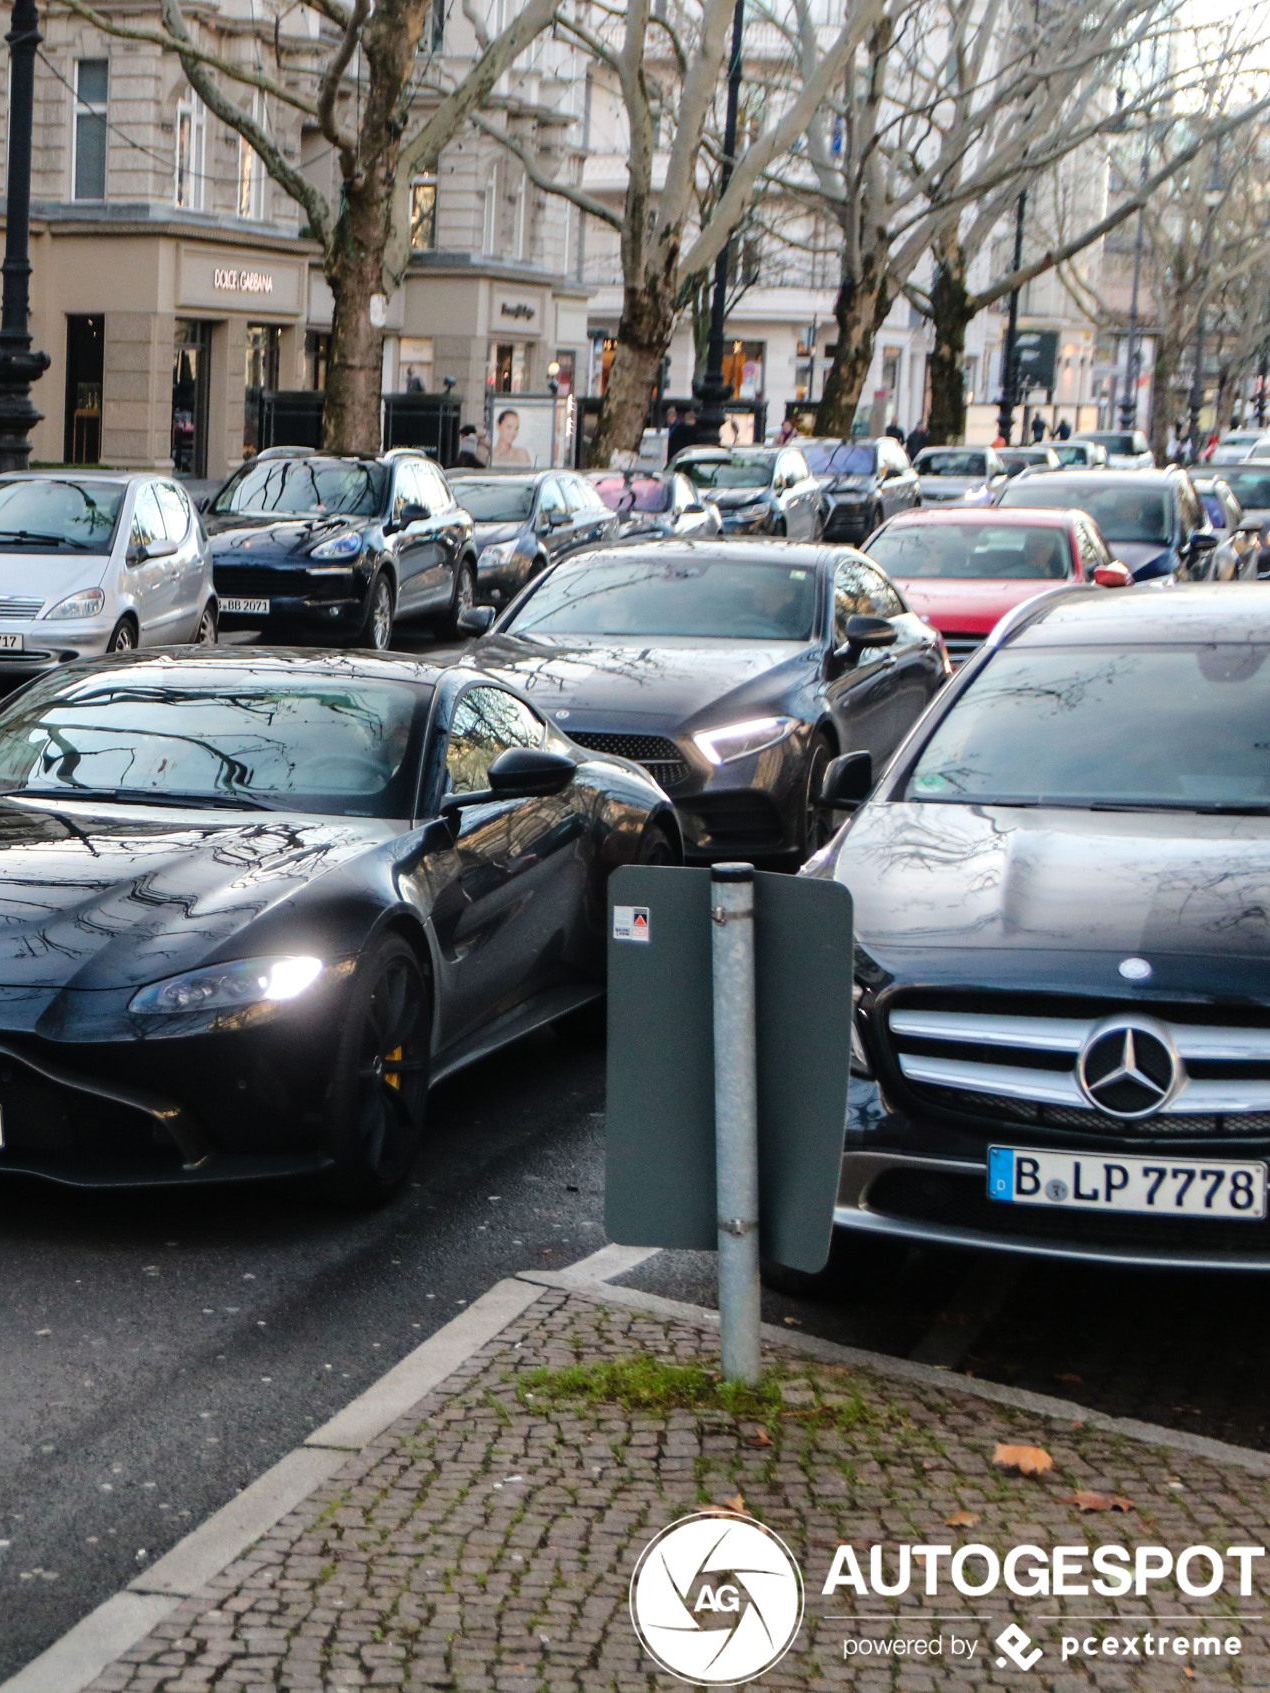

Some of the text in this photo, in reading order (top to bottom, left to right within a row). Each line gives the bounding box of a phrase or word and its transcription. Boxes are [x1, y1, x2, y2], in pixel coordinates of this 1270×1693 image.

[214, 268, 237, 290] DOLCE
[240, 270, 273, 293] GABBANA
[228, 600, 241, 611] BB
[243, 601, 267, 612] 2071
[997, 1156, 1255, 1211] D B LP 7778
